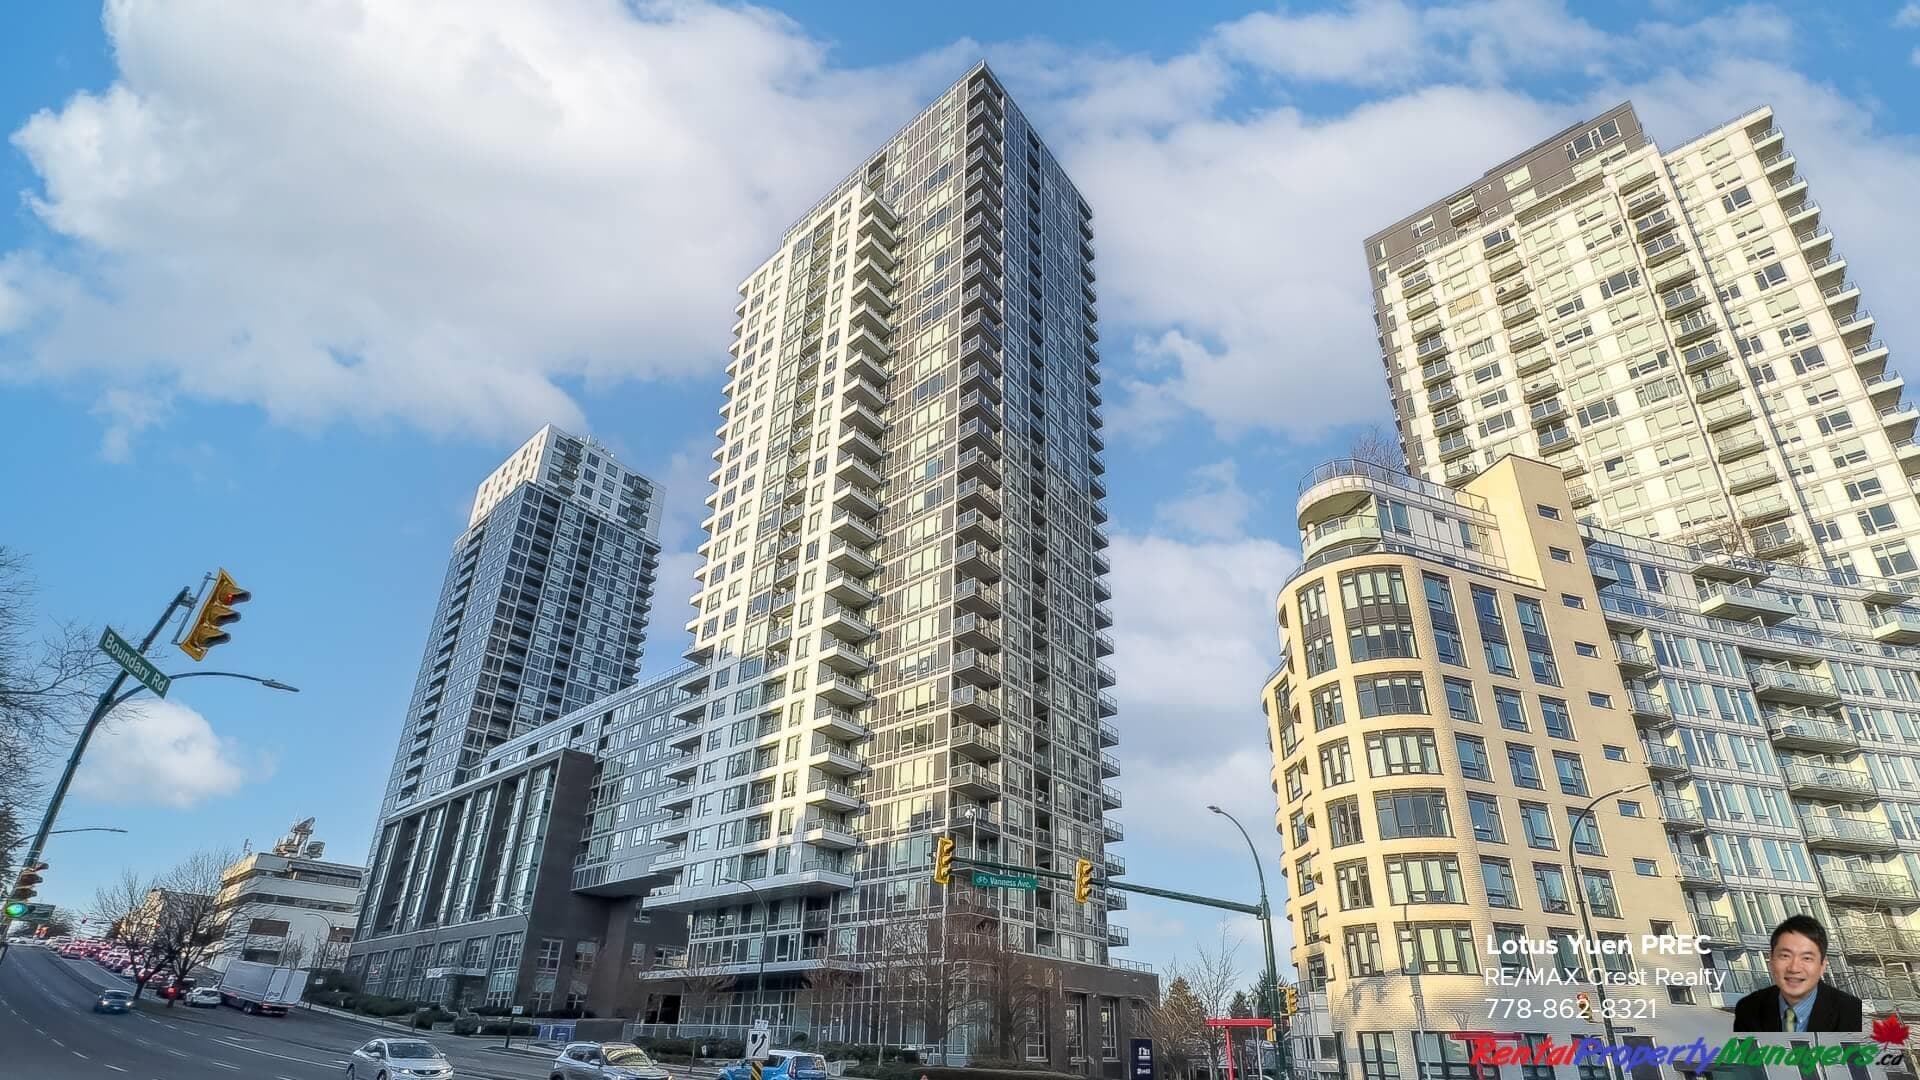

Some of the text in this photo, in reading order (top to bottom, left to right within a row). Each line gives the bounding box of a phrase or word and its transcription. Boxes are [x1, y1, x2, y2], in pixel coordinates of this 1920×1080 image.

[104, 633, 167, 692] Boundary Rd
[989, 876, 1017, 887] Vanness
